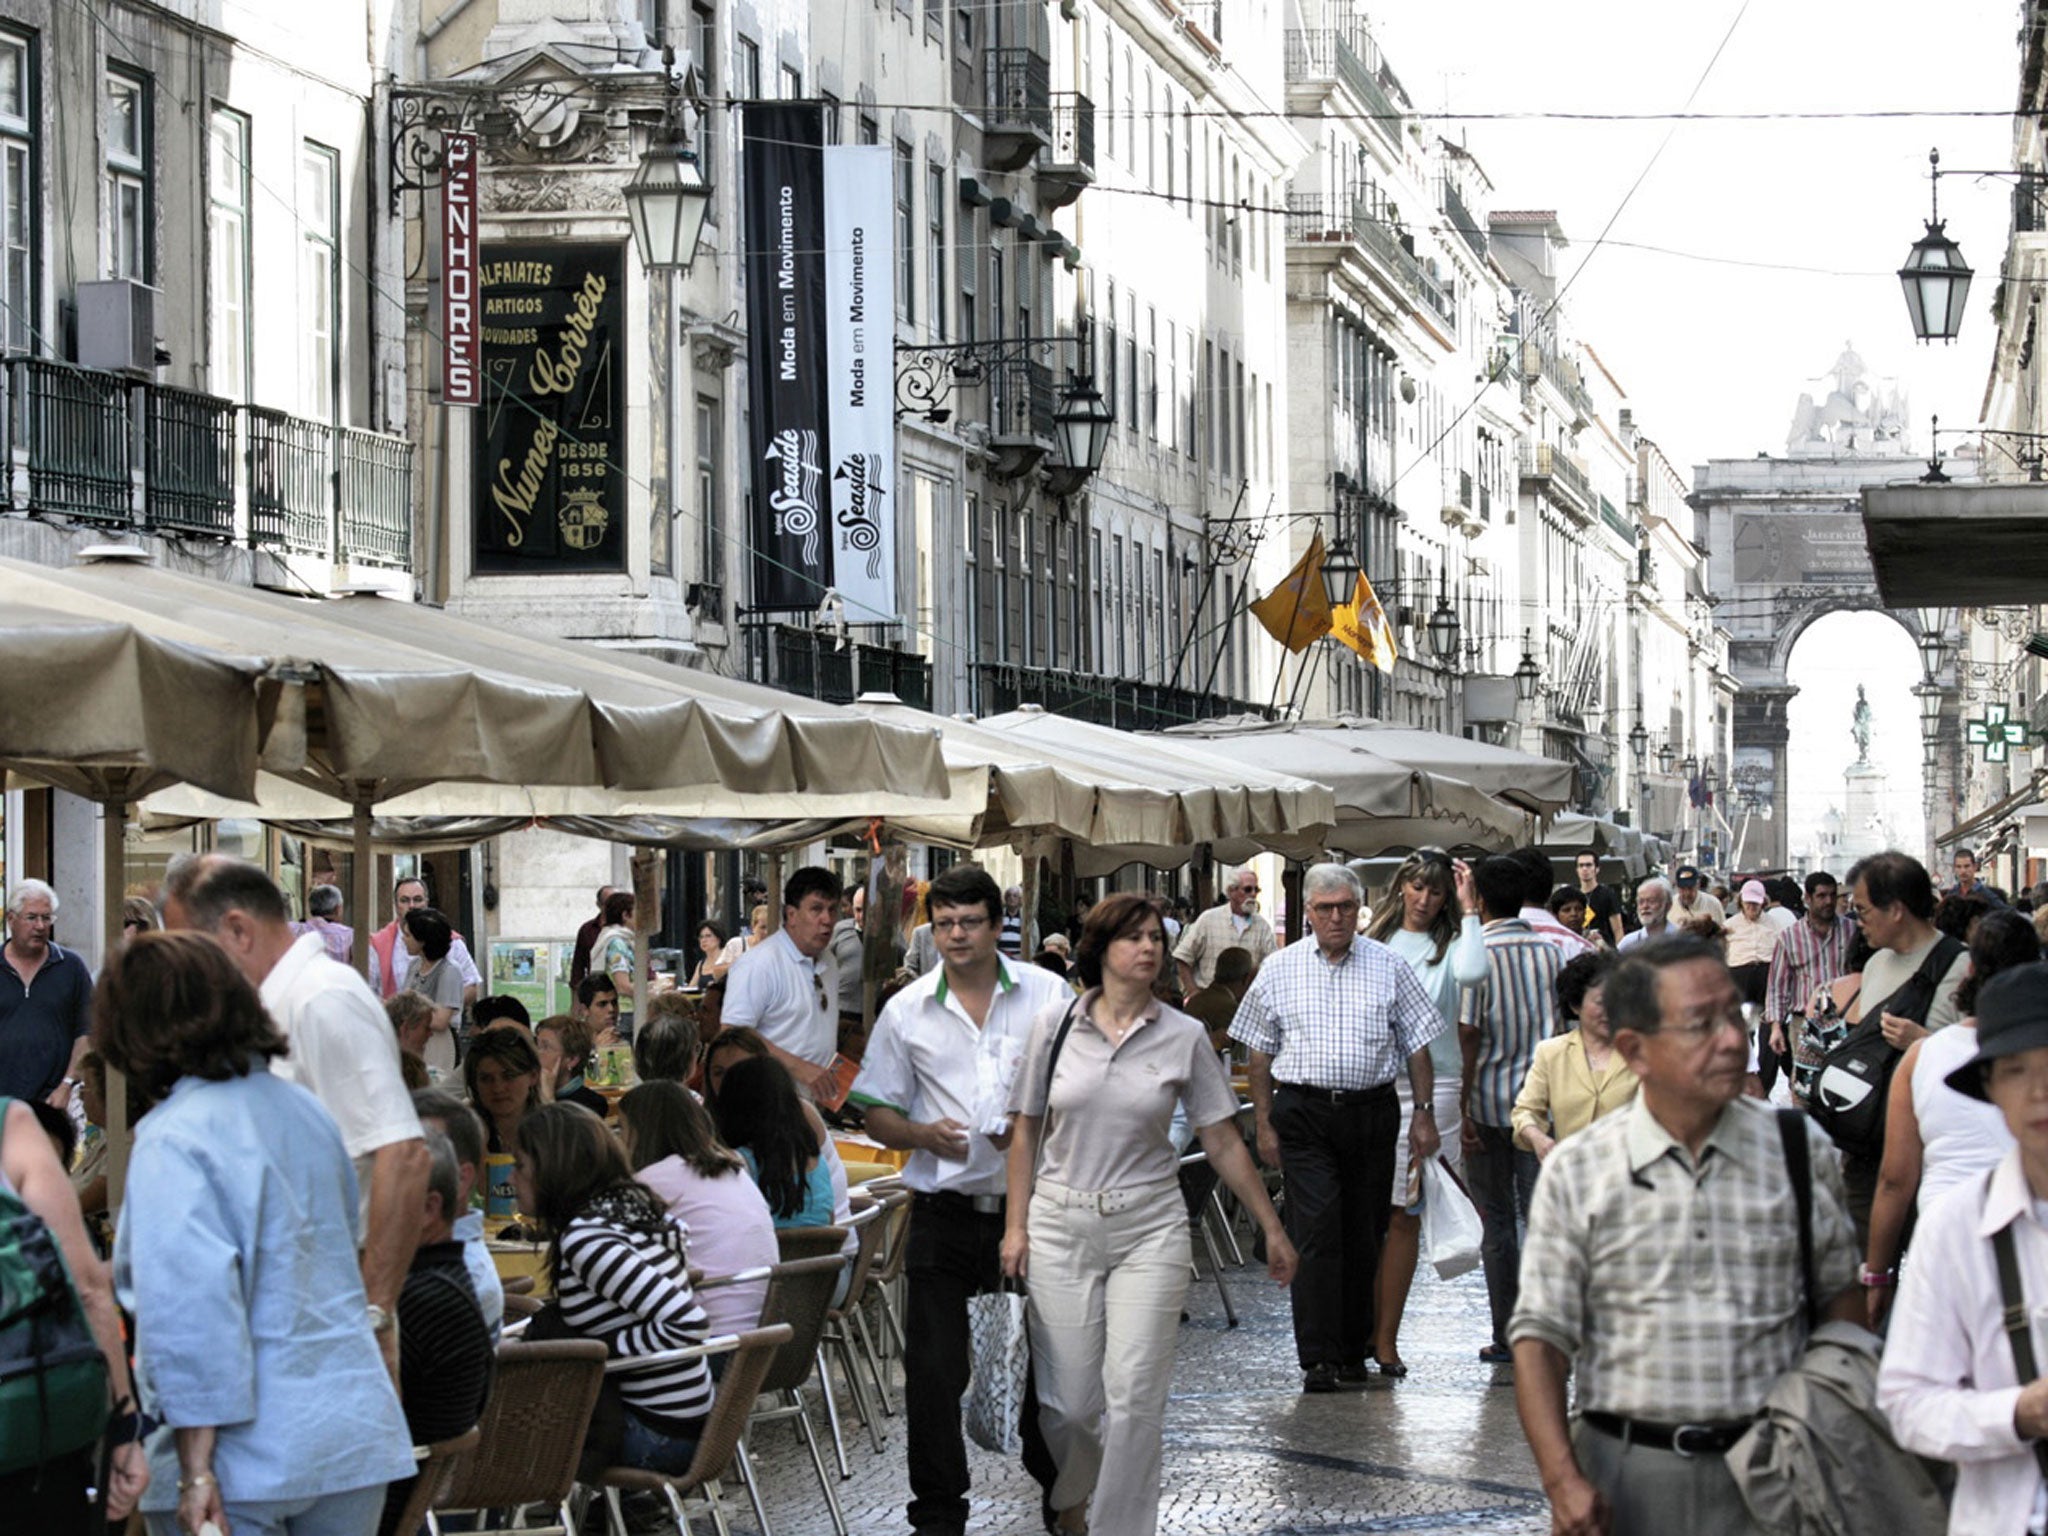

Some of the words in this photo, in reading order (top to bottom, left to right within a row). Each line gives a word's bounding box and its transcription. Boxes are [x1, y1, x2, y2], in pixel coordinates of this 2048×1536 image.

[778, 185, 794, 289] Movimento
[448, 138, 472, 398] PENHORES
[850, 227, 864, 322] Movimento
[486, 297, 543, 315] ARTIGOS
[783, 294, 796, 322] em
[780, 327, 797, 380] Moda
[853, 328, 865, 353] em
[850, 359, 865, 407] Moda
[559, 442, 608, 459] DESDE
[561, 463, 606, 477] 1856
[492, 414, 558, 547] Nunes
[769, 429, 818, 536] Seaside
[837, 452, 880, 551] Seaside
